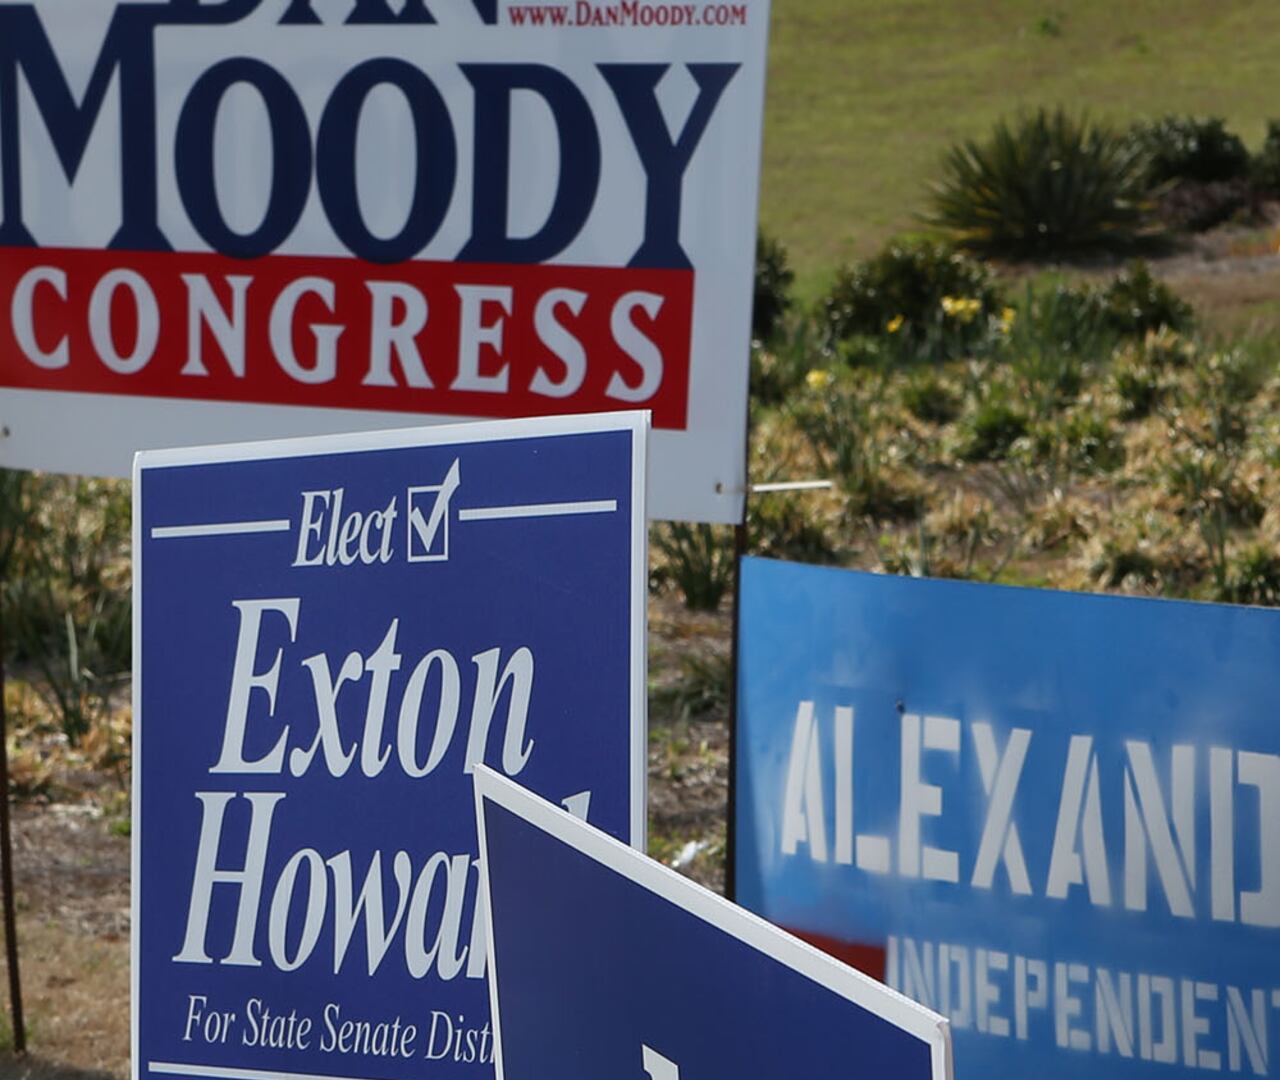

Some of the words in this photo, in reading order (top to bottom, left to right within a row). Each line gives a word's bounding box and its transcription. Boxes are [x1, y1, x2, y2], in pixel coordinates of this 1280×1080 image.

[10, 266, 664, 402] CONGRESS
[291, 488, 398, 567] Elect
[208, 597, 535, 778] Exton
[182, 994, 235, 1045] For
[242, 997, 312, 1051] State
[319, 1003, 417, 1058] Senate
